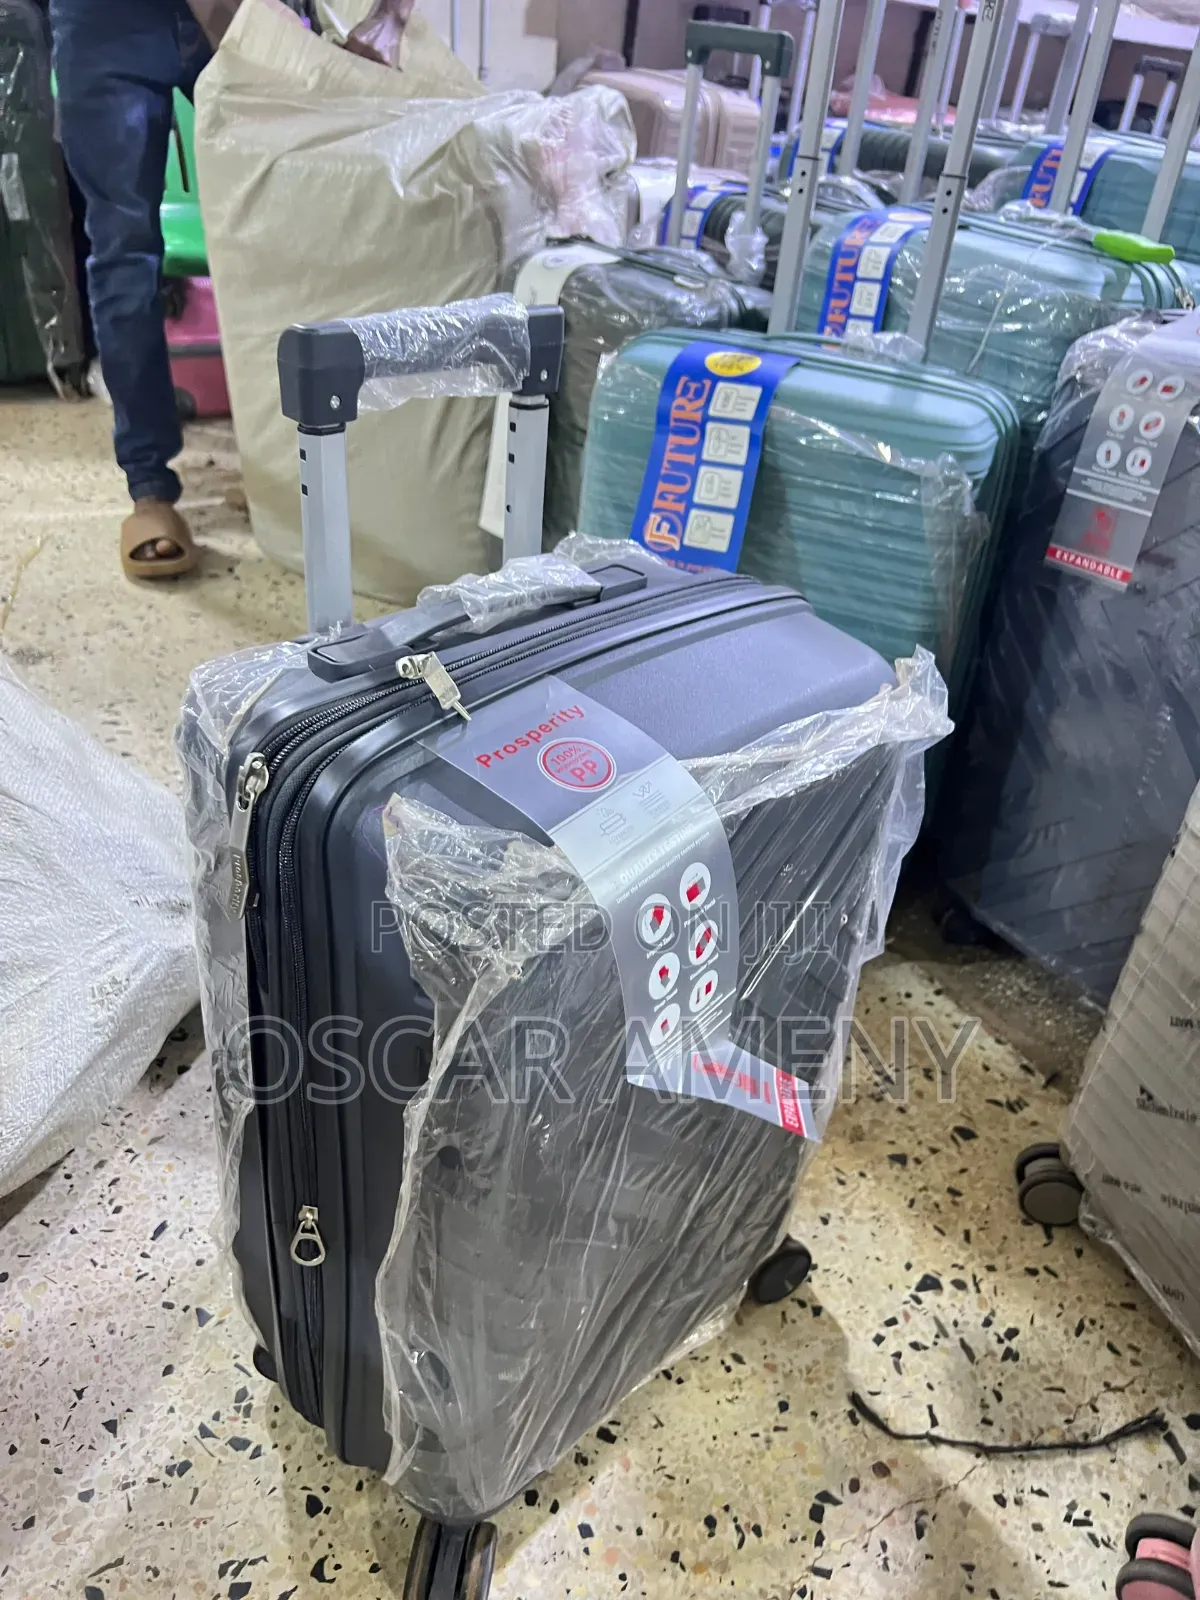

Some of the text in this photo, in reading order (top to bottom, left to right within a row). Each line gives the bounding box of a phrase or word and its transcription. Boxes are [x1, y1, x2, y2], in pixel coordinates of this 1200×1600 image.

[652, 374, 712, 514] FUTURE
[1055, 549, 1124, 580] EXPANDABLE
[475, 704, 585, 769] Prosperity
[550, 745, 582, 766] 100%
[569, 759, 599, 783] PP
